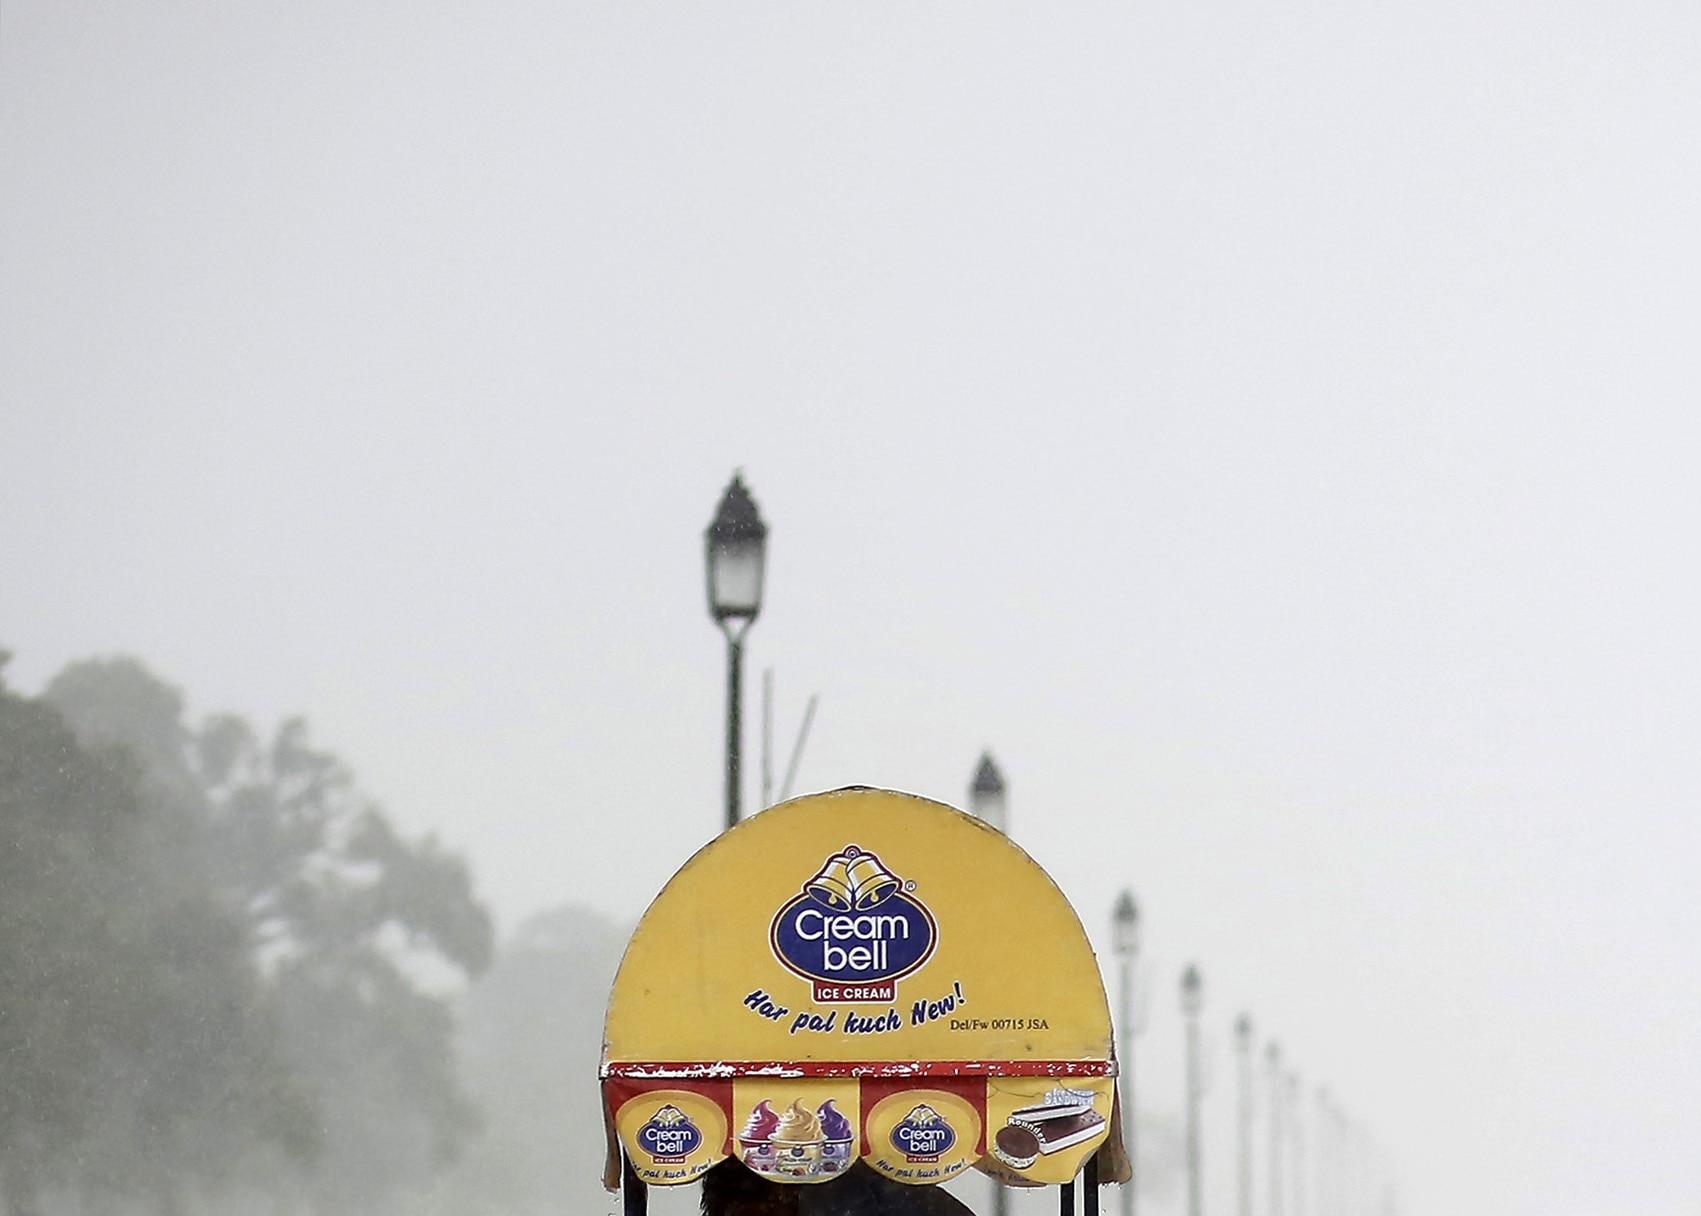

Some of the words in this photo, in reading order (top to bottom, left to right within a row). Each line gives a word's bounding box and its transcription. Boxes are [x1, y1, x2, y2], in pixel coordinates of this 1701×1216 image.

[795, 909, 909, 940] Cream
[823, 940, 888, 971] bell
[817, 987, 839, 1000] ICE
[843, 987, 891, 1000] CREAM
[743, 988, 789, 1021] Har
[790, 1010, 837, 1035] pal
[844, 1008, 902, 1034] kuch
[911, 982, 967, 1026] New!
[991, 1019, 1025, 1030] 00715
[1026, 1019, 1050, 1030] JSA
[645, 1128, 692, 1141] Cream
[899, 1127, 945, 1140] Cream
[1007, 1117, 1047, 1144] Rounder
[656, 1140, 683, 1153] bell
[910, 1140, 937, 1152] bell
